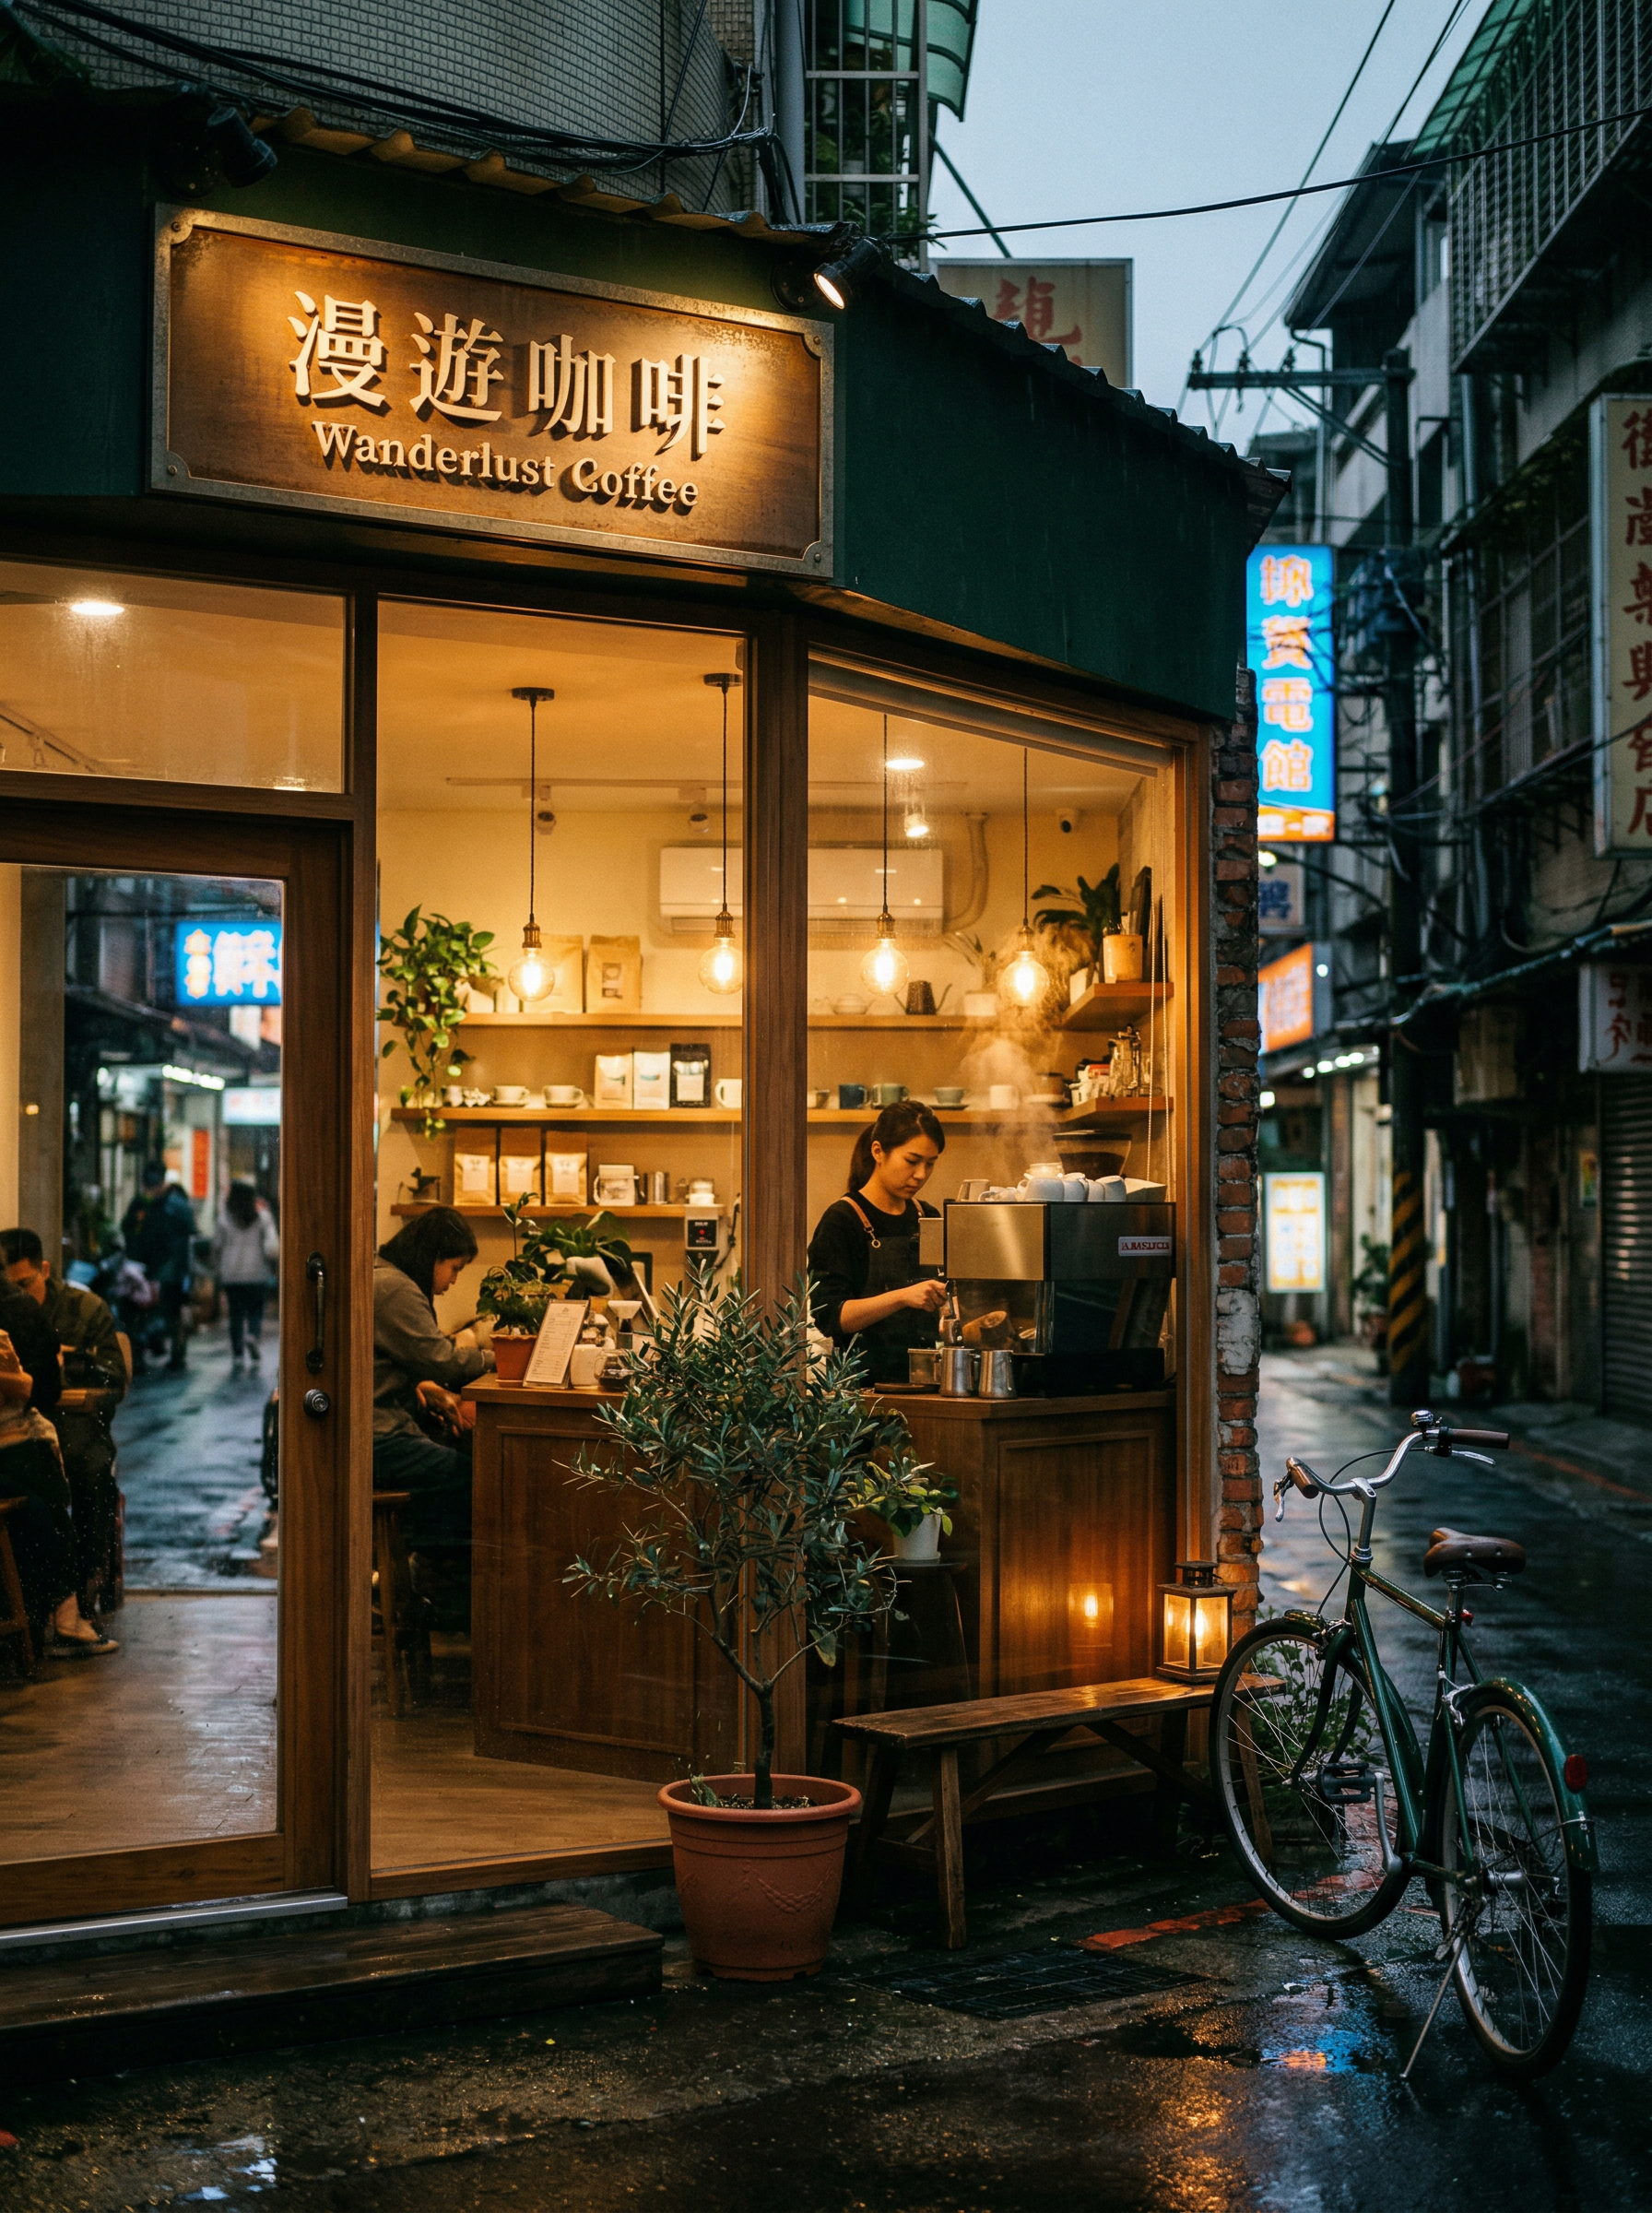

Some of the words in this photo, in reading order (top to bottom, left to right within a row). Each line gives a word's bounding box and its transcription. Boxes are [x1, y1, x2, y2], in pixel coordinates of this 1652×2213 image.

[287, 290, 726, 456] 漫遊咖啡
[311, 420, 556, 489] Wanderlust
[572, 456, 701, 508] Coffee
